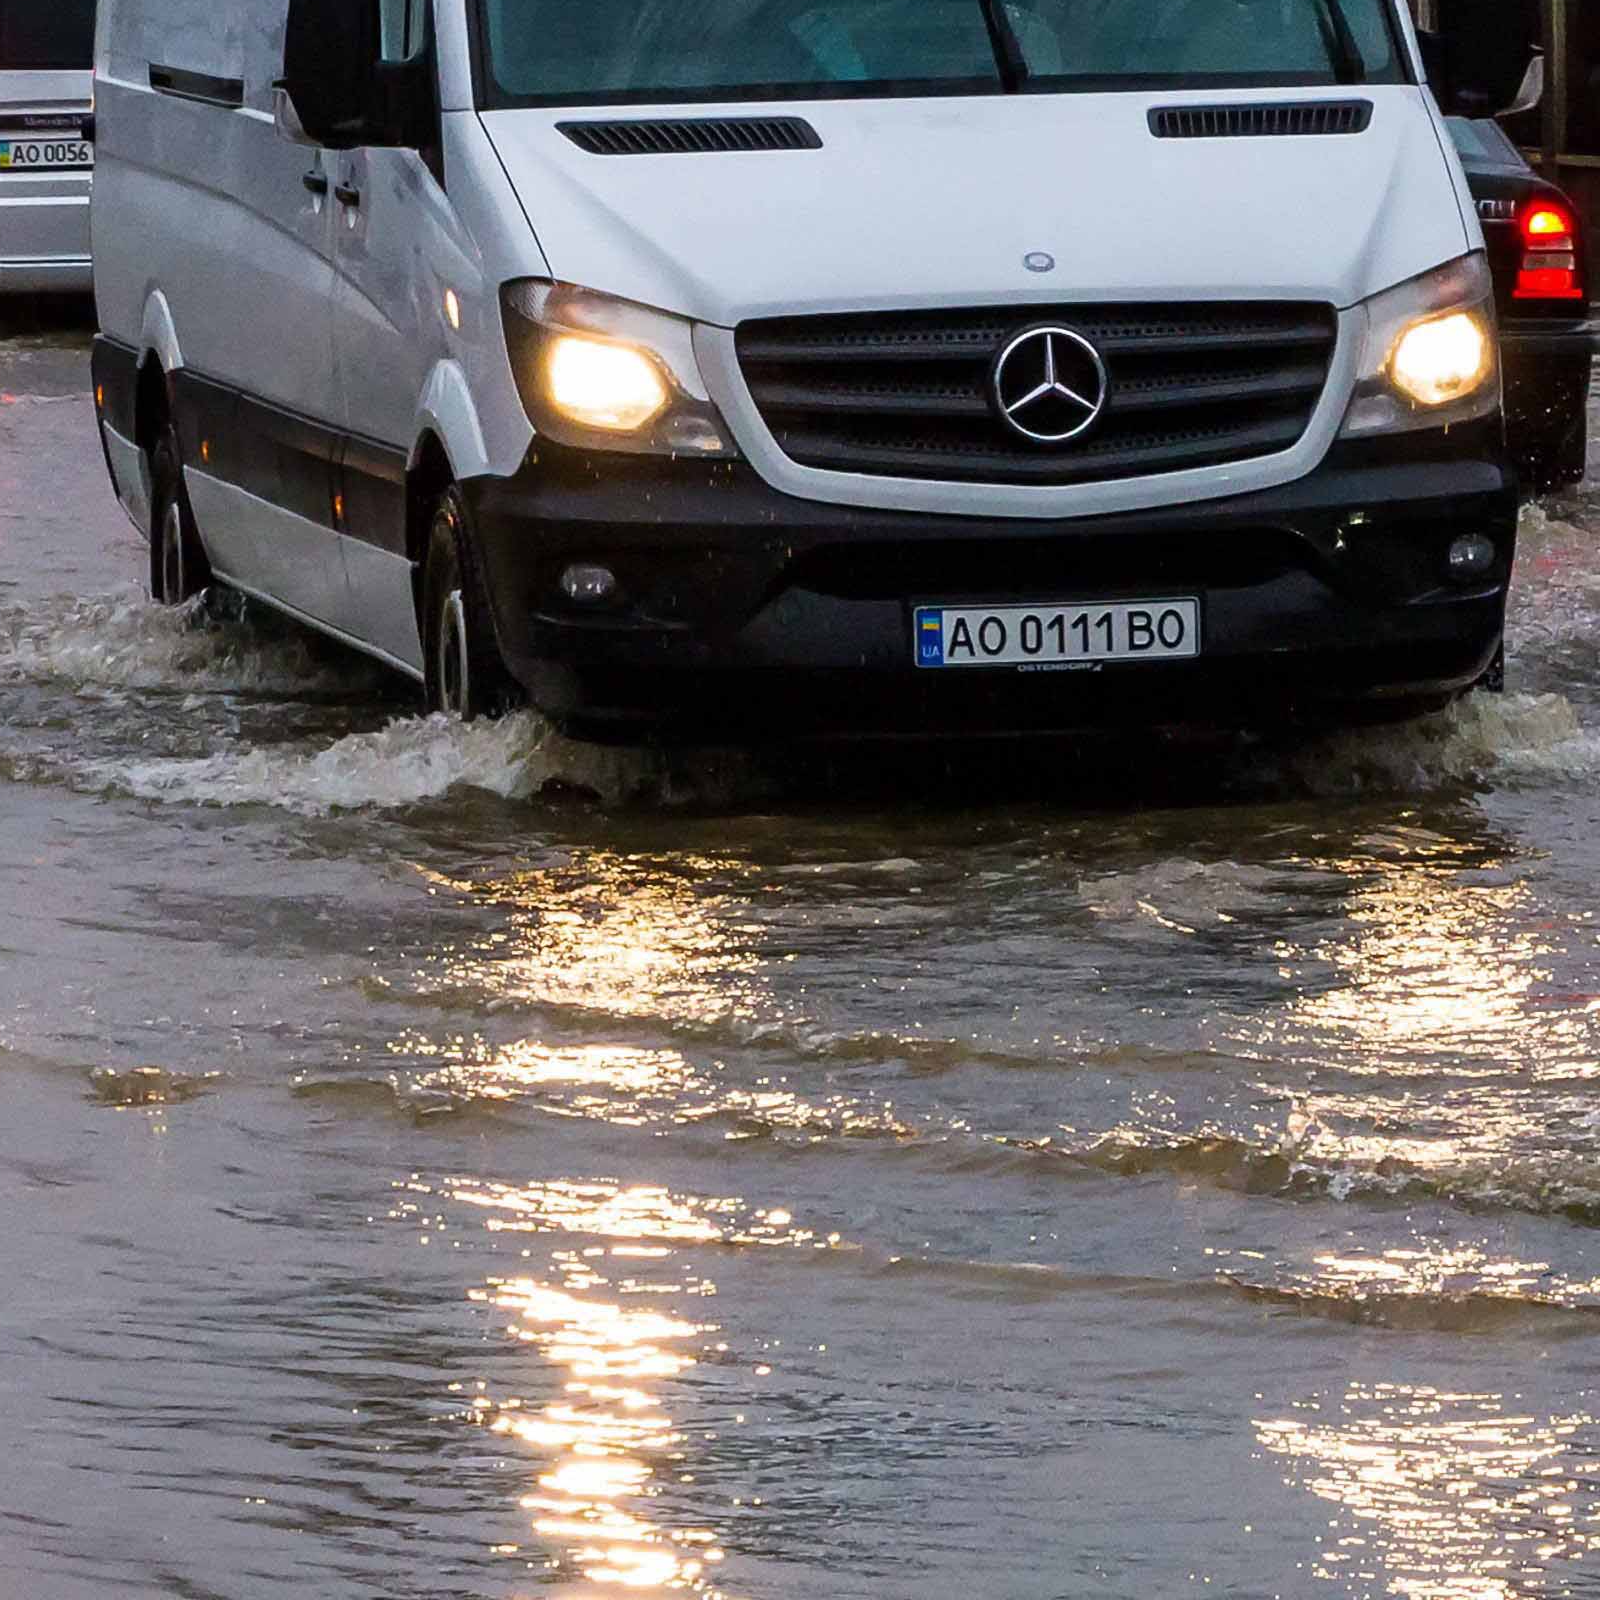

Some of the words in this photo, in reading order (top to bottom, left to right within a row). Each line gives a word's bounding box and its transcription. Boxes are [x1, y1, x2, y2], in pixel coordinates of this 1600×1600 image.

[12, 144, 40, 164] AO
[44, 143, 89, 162] 0056
[921, 646, 941, 658] UA
[948, 615, 1008, 658] AO
[1020, 610, 1116, 655] 0111
[1127, 608, 1186, 652] BO
